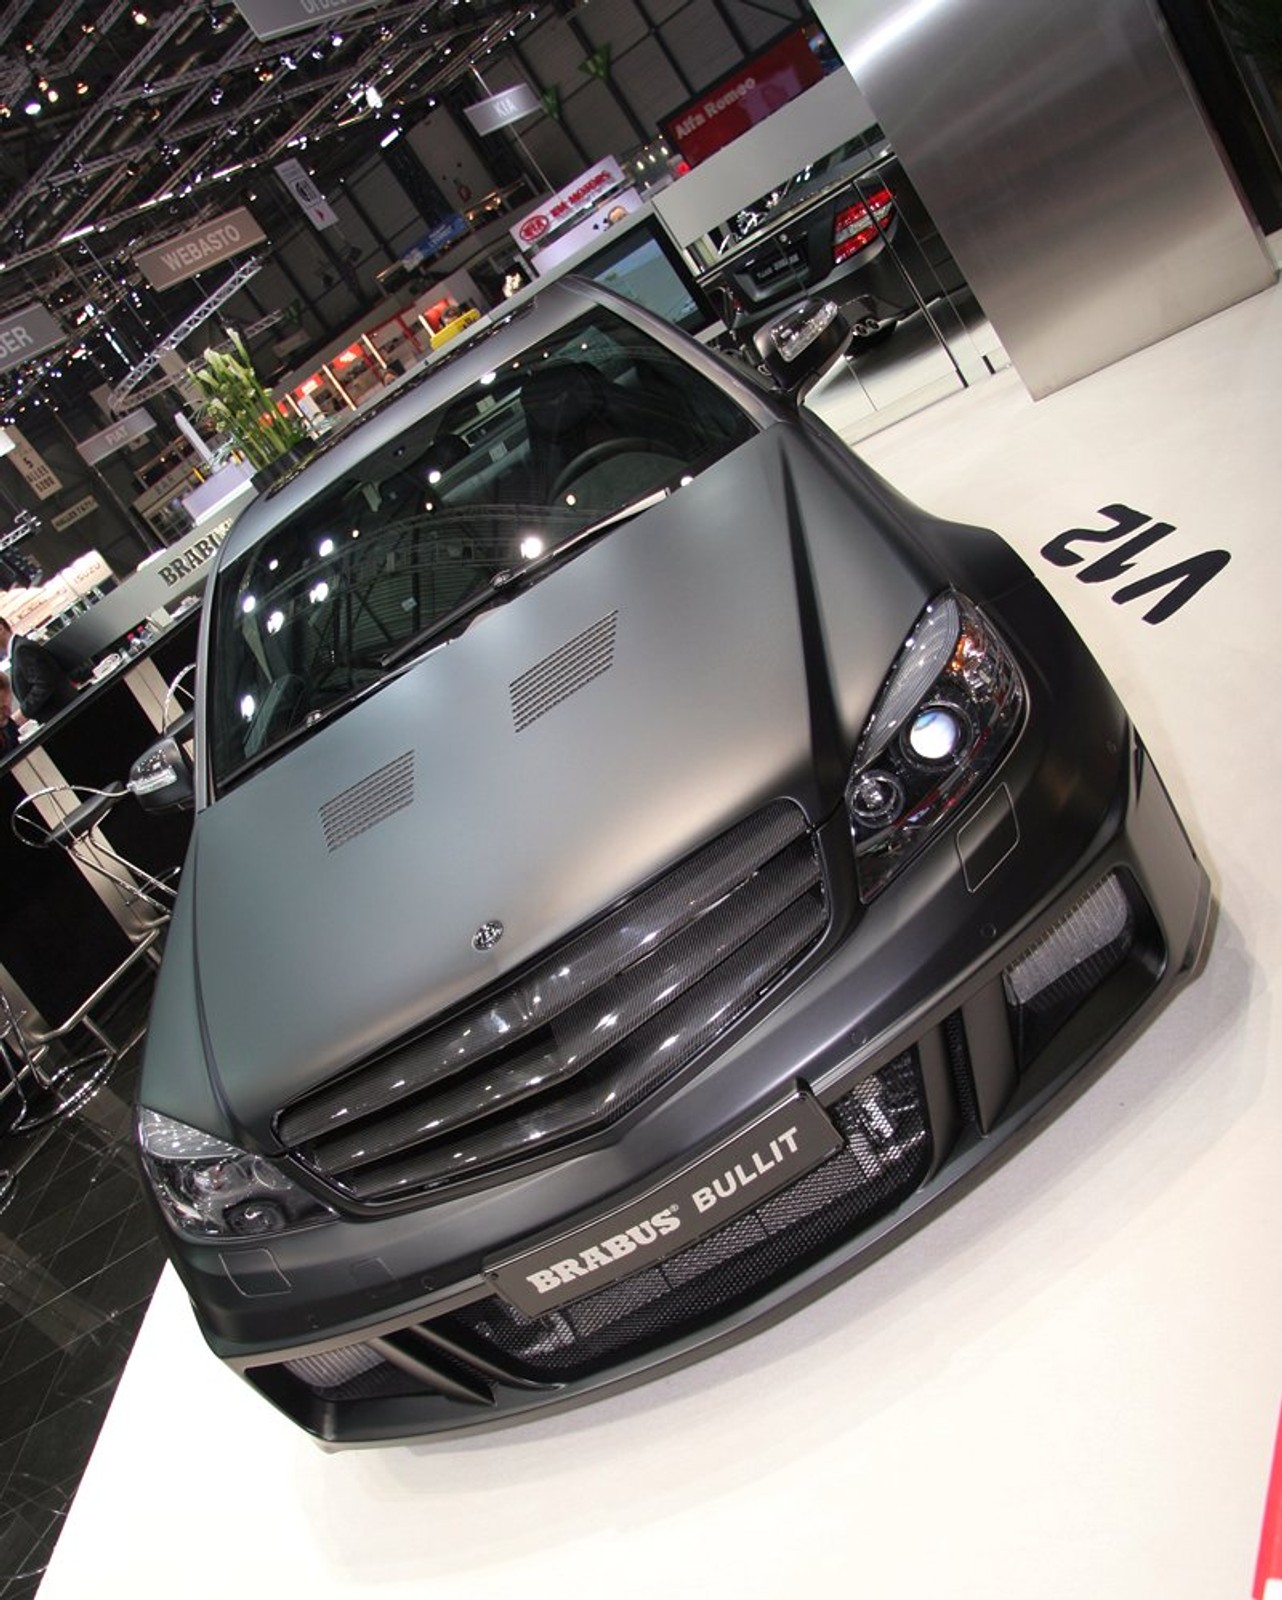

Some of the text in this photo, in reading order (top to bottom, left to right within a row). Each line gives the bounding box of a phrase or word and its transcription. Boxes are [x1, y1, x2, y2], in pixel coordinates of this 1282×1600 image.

[492, 97, 519, 118] KIA
[675, 77, 756, 140] Alfa Romeo
[160, 224, 241, 271] WEBASTO
[74, 562, 101, 584] ISUZU
[1040, 503, 1232, 625] V12
[692, 1126, 799, 1214] BULLIT
